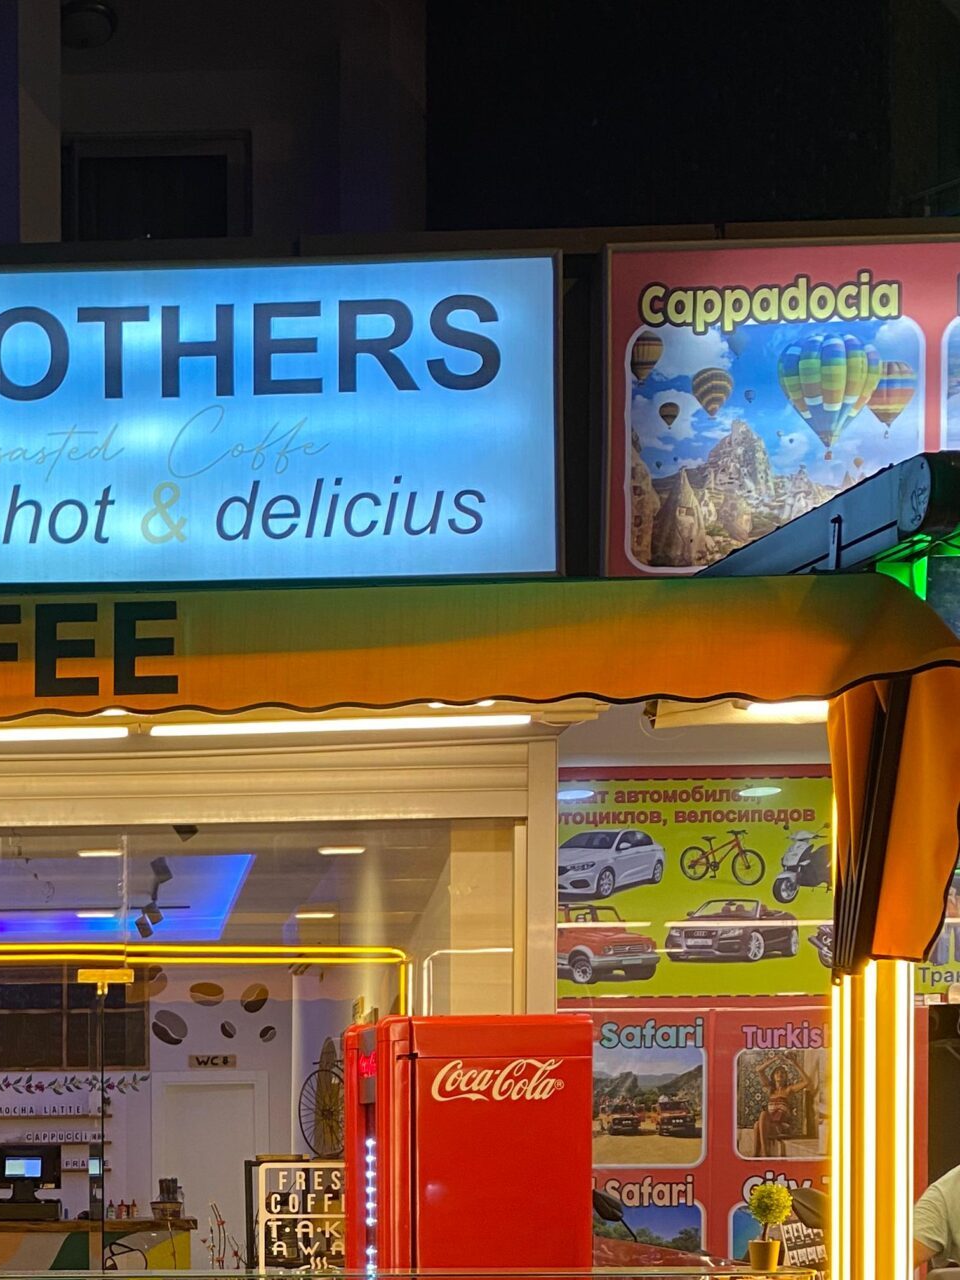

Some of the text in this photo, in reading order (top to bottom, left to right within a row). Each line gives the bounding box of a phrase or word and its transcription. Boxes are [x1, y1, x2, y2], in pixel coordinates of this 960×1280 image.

[639, 270, 901, 334] Cappadocia
[2, 484, 115, 545] hot
[139, 482, 188, 544] &
[215, 475, 485, 541] delicius
[674, 808, 816, 825] велосипедов
[600, 1017, 705, 1049] Safari
[195, 1055, 219, 1066] WC
[431, 1058, 564, 1101] Coca-Cola
[44, 1106, 81, 1115] LATTE
[279, 1171, 341, 1190] FRES
[604, 1174, 694, 1207] Safari
